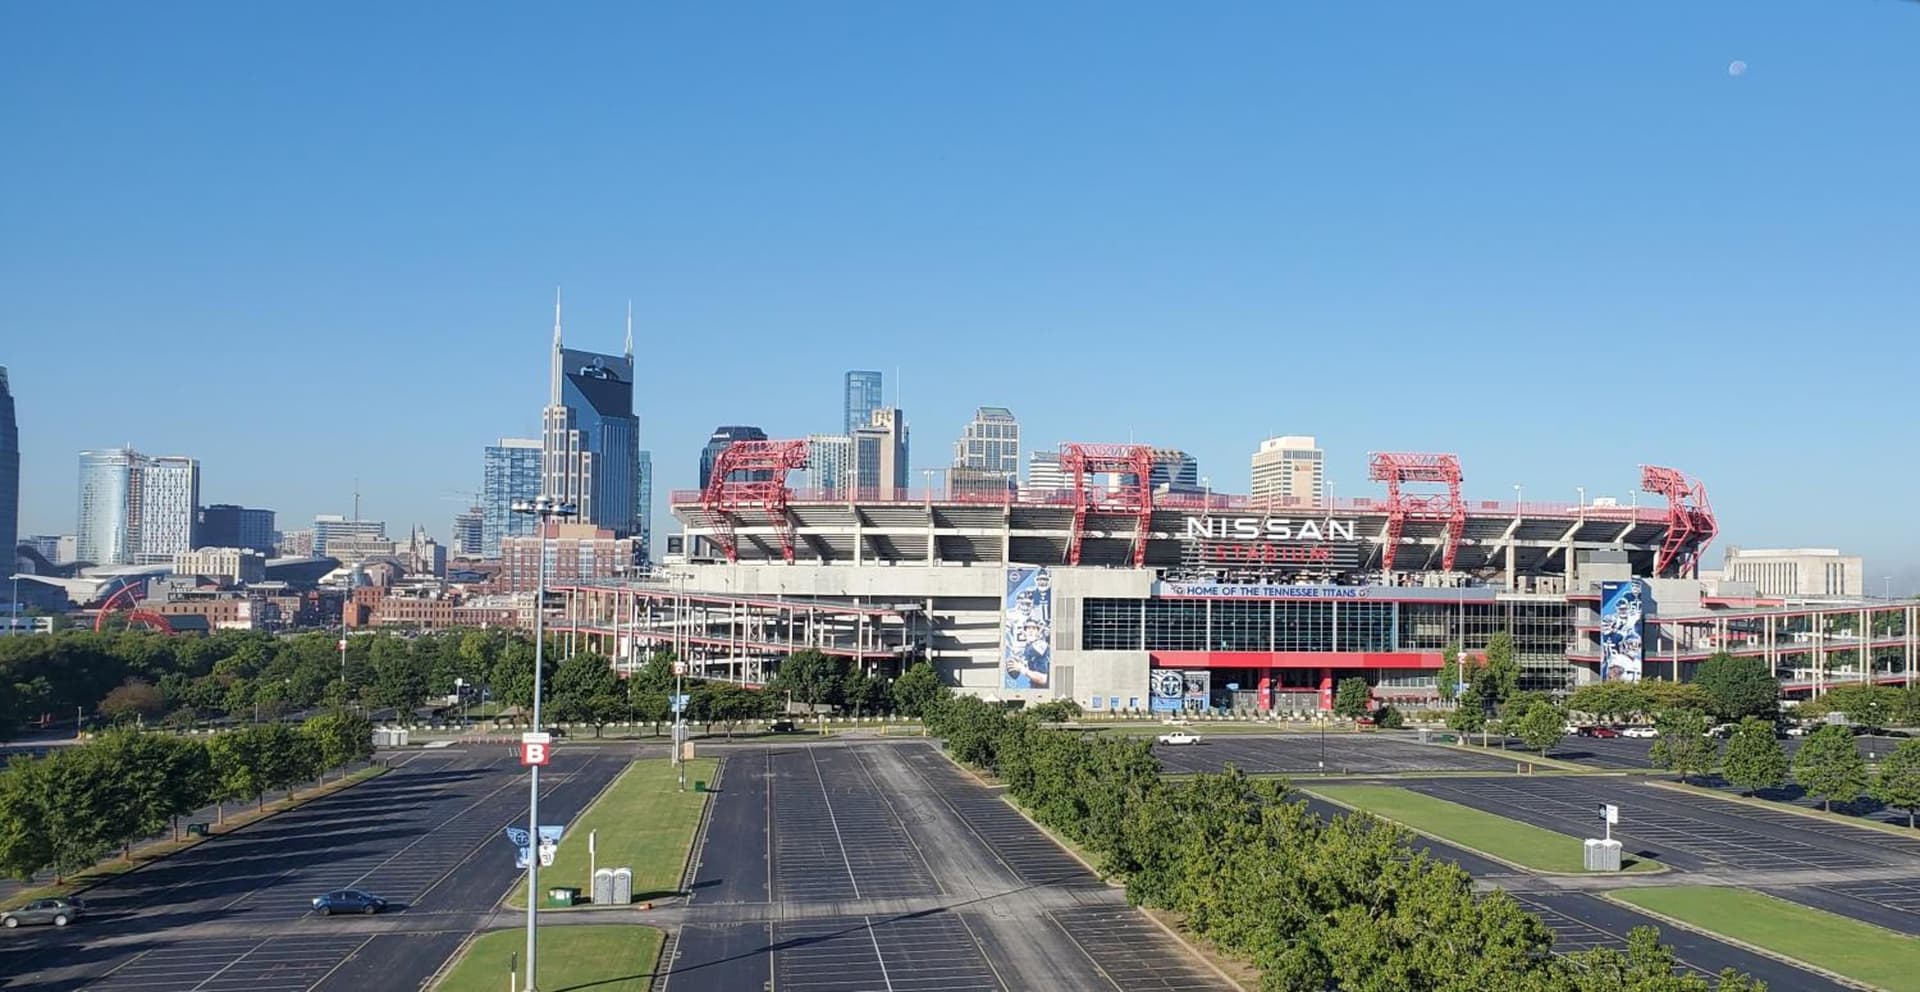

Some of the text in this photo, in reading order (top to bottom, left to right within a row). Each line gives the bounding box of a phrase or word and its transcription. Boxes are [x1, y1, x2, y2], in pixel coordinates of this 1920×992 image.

[1187, 517, 1354, 541] NISSAN
[1216, 545, 1329, 561] STADIUM
[1187, 586, 1356, 598] HOME OF THE TENNESSEE TITANS
[526, 744, 545, 764] B
